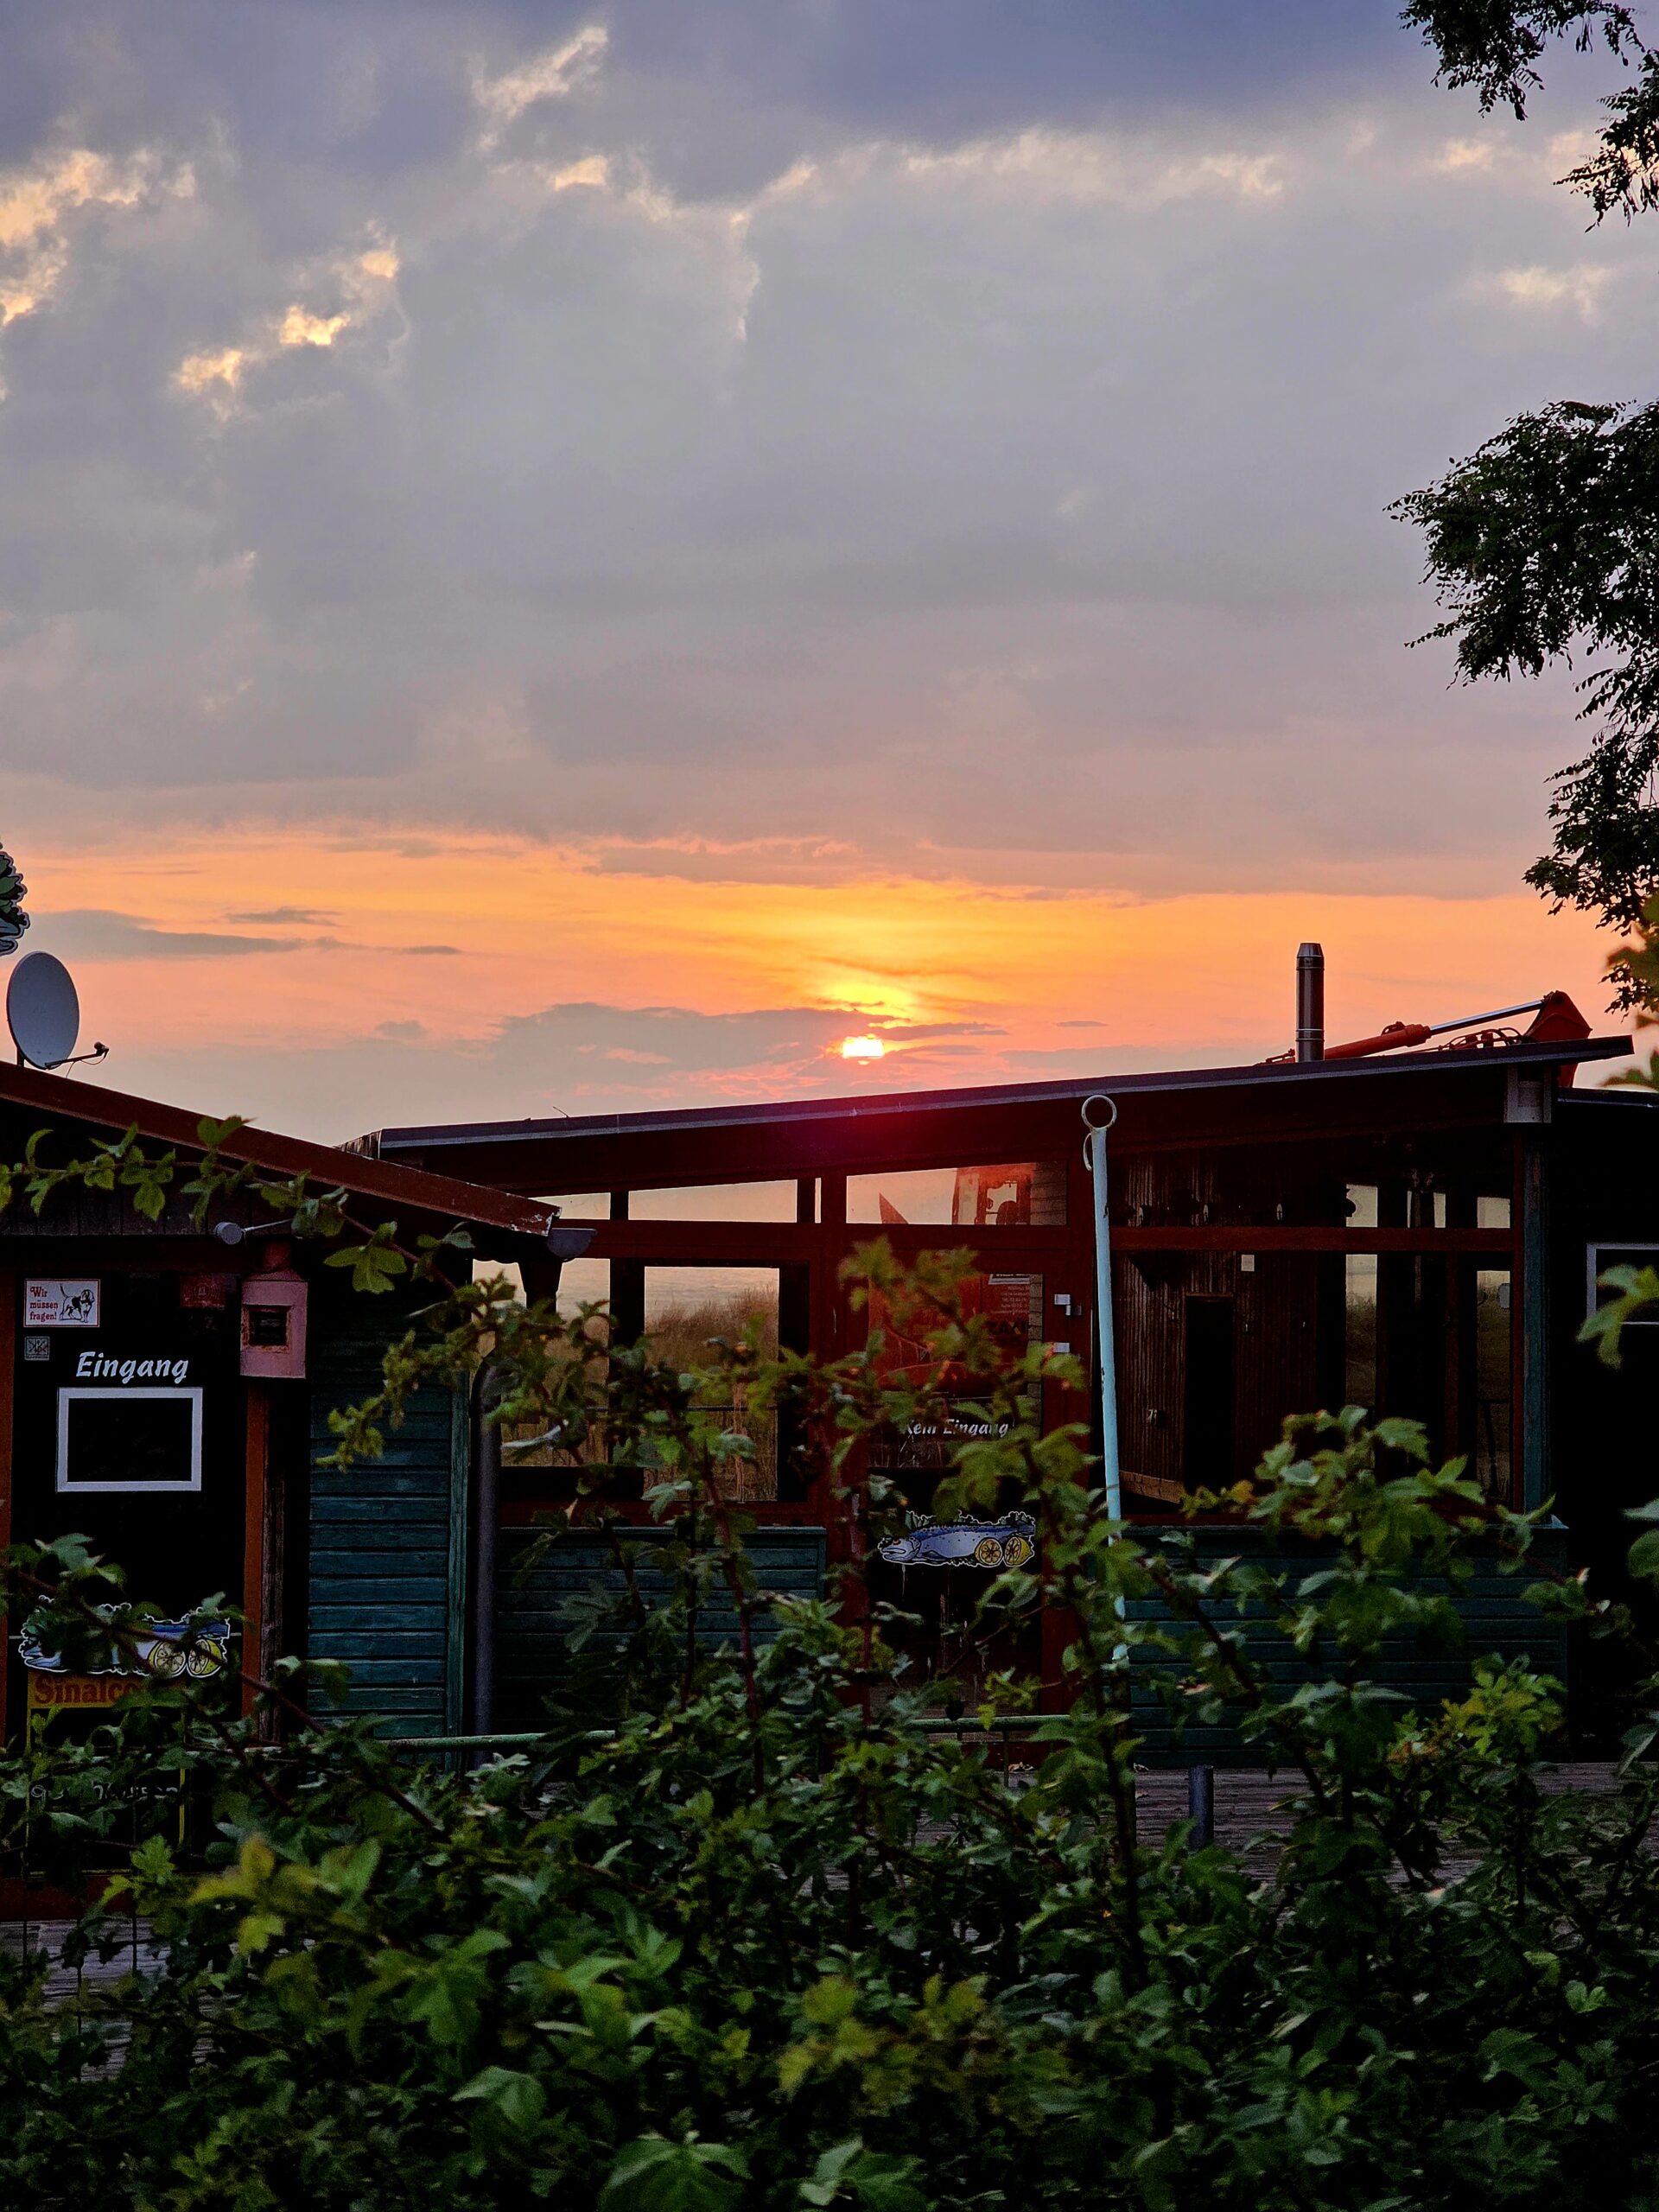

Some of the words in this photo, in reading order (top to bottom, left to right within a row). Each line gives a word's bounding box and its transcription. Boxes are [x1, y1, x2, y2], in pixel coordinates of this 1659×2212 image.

[30, 1287, 48, 1297] Wir
[30, 1300, 58, 1309] müssen
[30, 1311, 57, 1322] fragen!
[75, 1351, 189, 1384] Eingang
